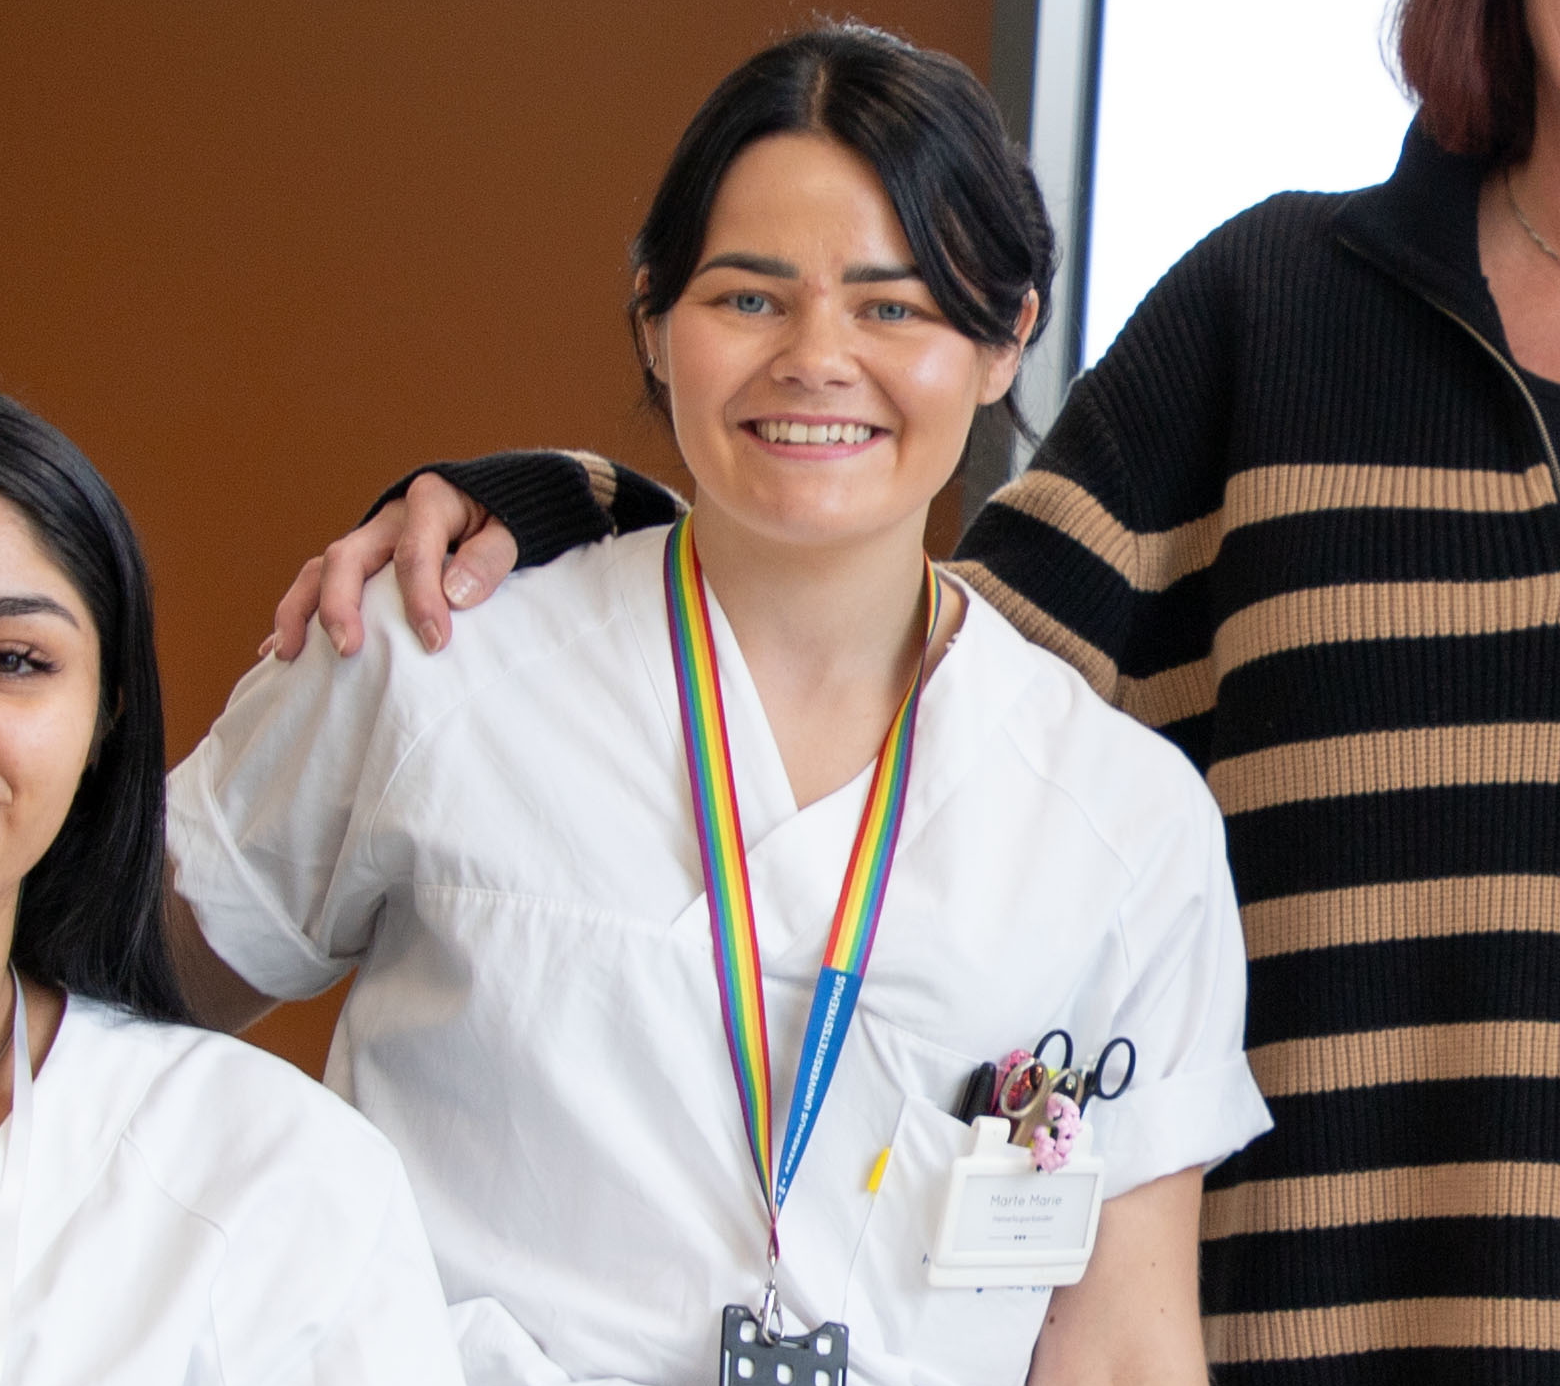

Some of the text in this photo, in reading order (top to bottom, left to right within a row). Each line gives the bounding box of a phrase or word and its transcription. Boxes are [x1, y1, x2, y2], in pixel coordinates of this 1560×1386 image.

[803, 974, 847, 1111] UNIVERSITETSSYKEHUS
[990, 1194, 1062, 1208] Marte Marie
